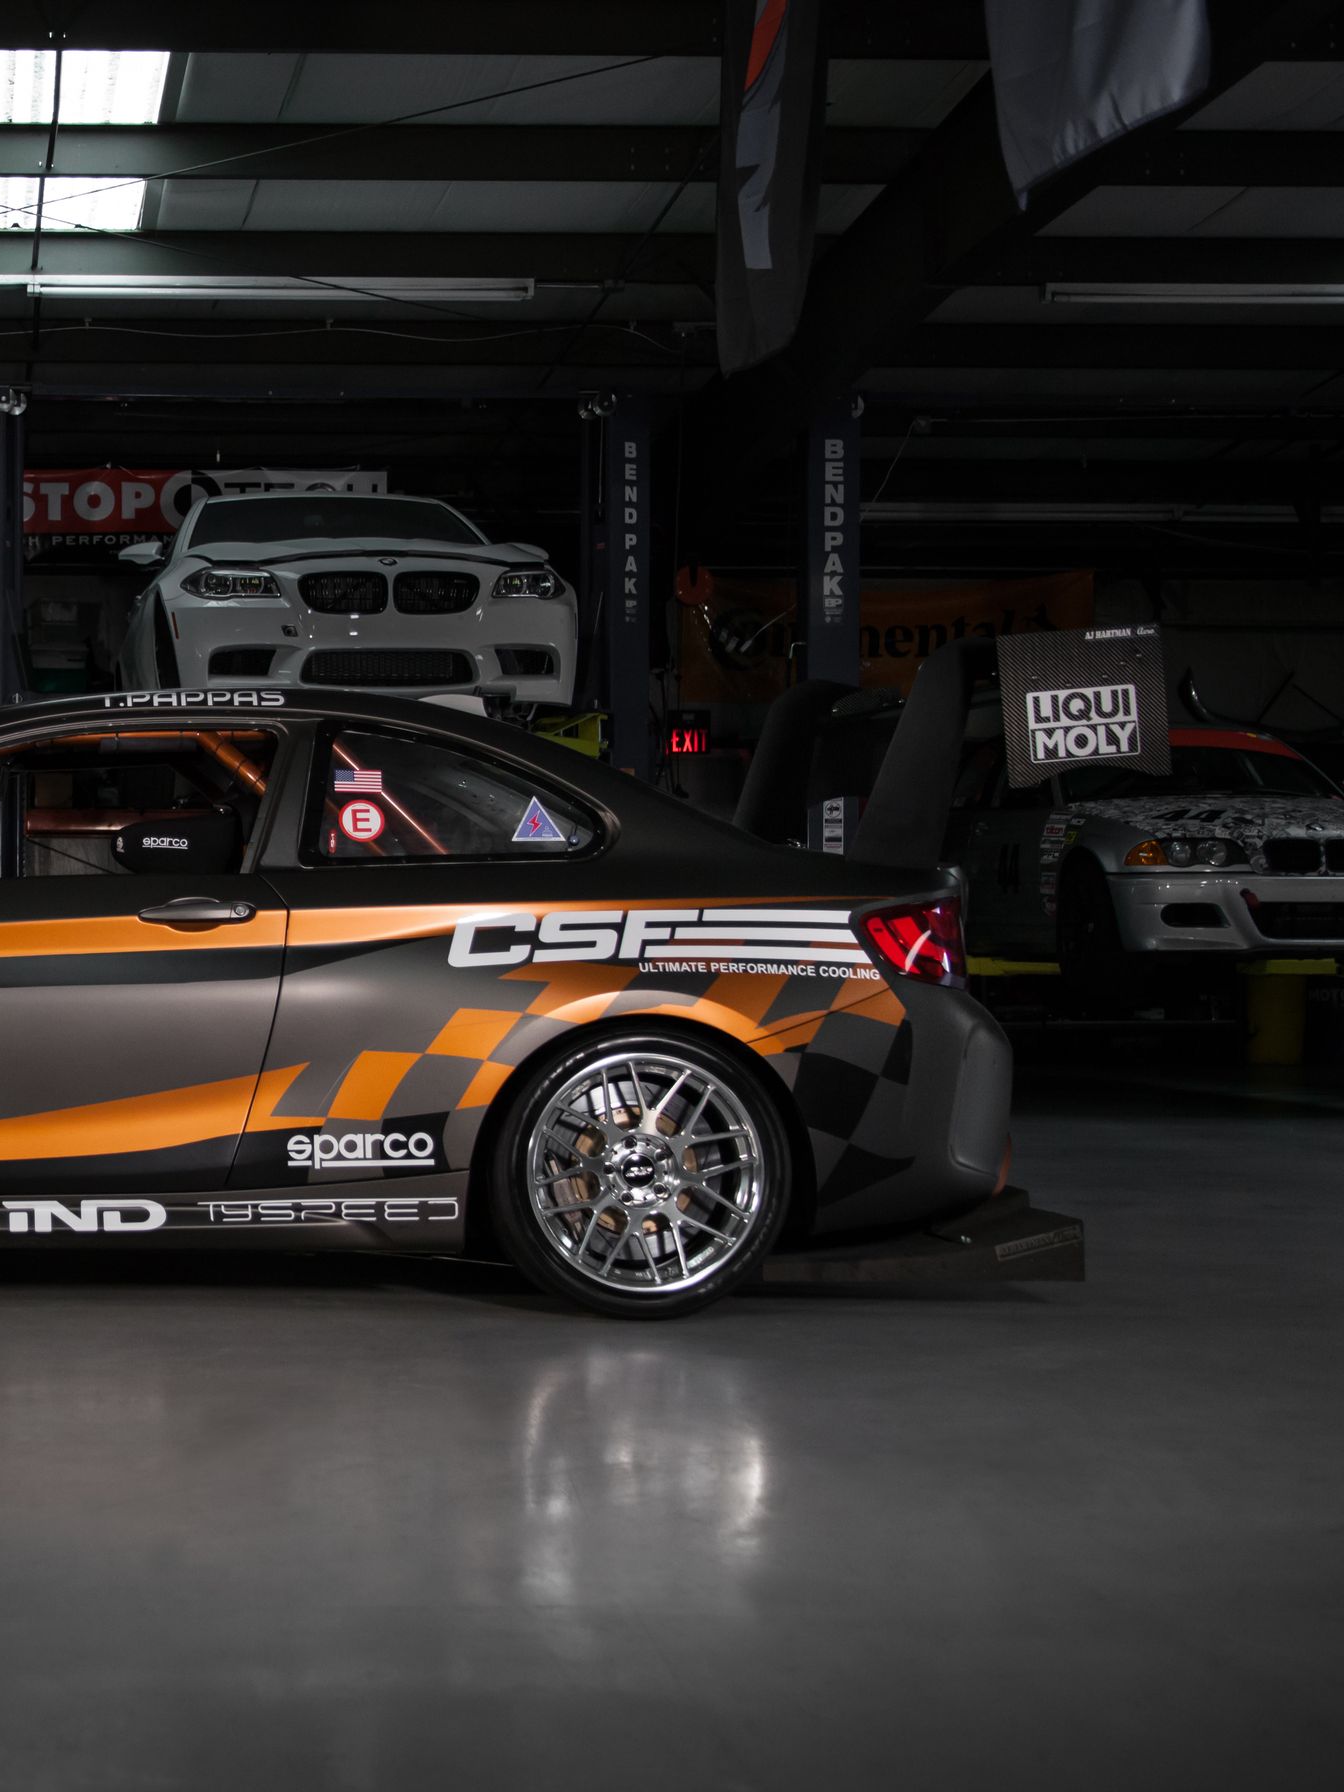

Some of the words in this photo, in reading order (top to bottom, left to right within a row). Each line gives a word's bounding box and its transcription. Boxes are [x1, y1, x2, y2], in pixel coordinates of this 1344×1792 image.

[1032, 688, 1132, 724] LIQUI
[671, 728, 709, 753] EXIT
[1034, 722, 1137, 761] MOLY
[351, 808, 373, 834] E
[142, 836, 189, 850] sparco
[447, 908, 700, 968] CSF
[638, 961, 707, 975] ULTIMATE
[710, 962, 817, 978] PERFORMANCE
[818, 964, 881, 981] COOLING
[286, 1131, 435, 1169] sparco
